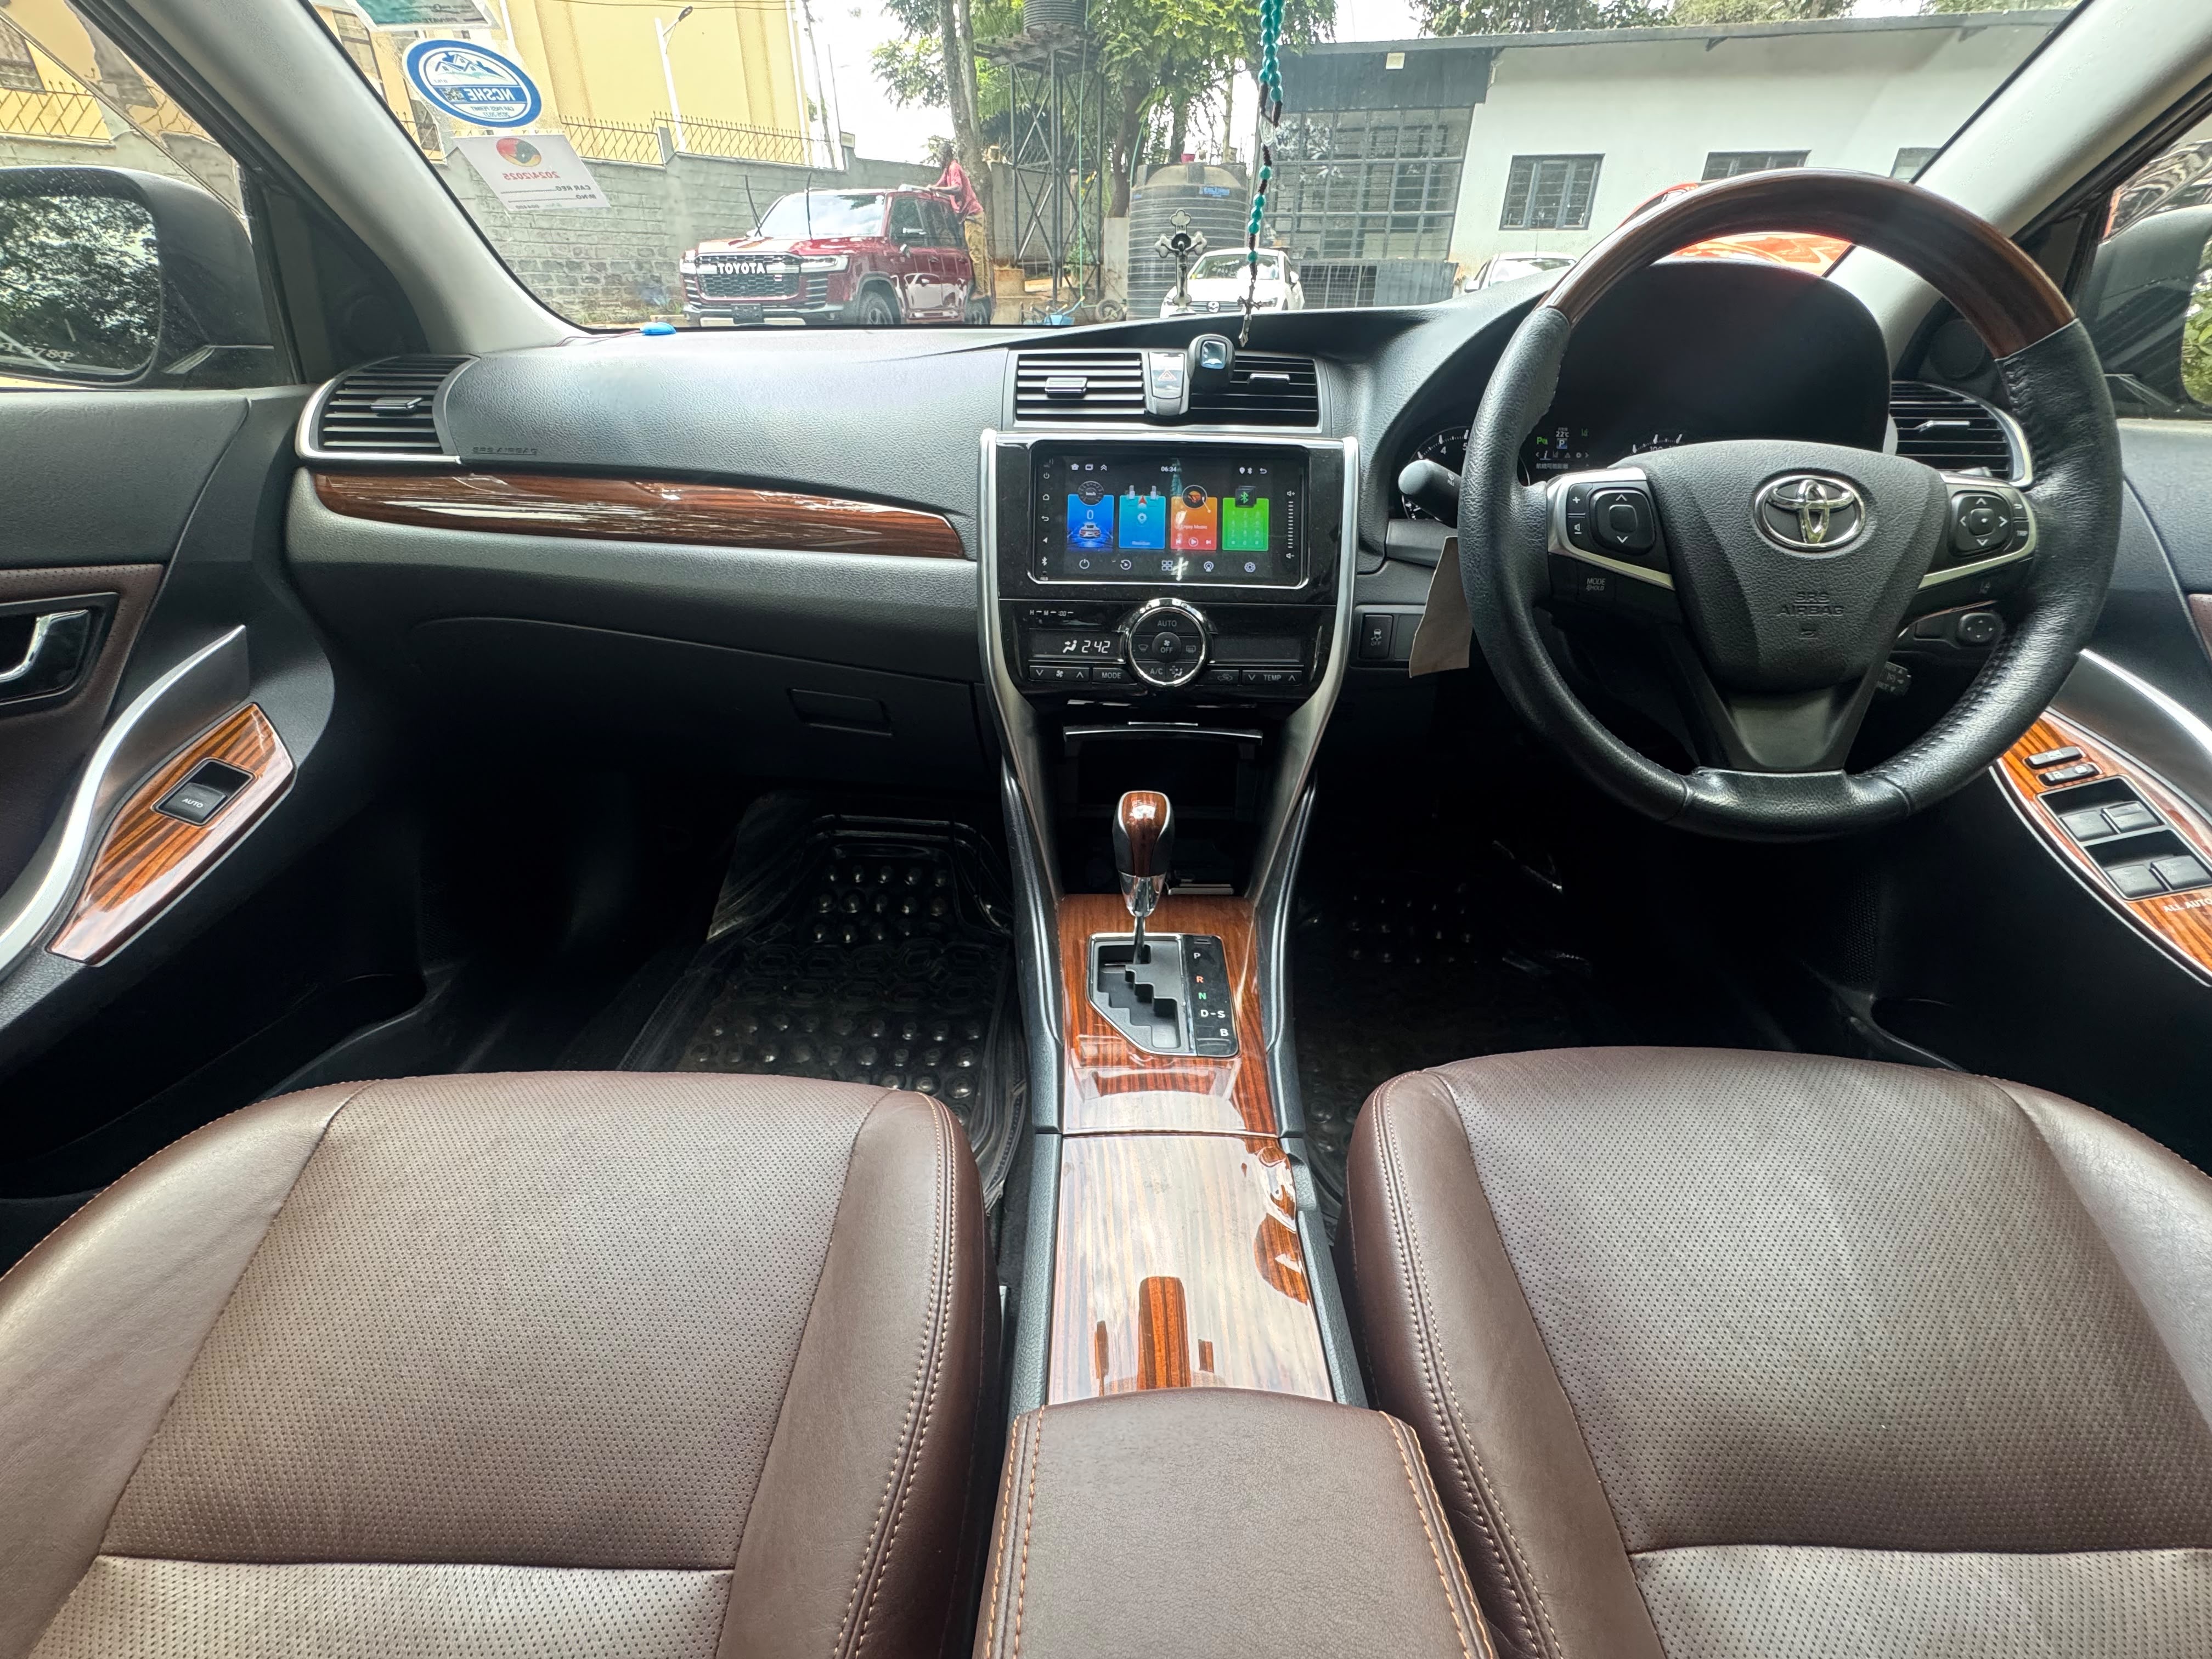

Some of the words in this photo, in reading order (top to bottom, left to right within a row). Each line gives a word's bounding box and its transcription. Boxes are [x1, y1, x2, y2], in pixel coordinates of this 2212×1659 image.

[717, 262, 766, 274] TOYOTA
[1440, 446, 1447, 455] 4
[1086, 509, 1094, 520] 0
[1794, 592, 1830, 603] SRS
[1776, 605, 1844, 617] AIRBAG
[182, 798, 204, 808] AUTO
[2163, 904, 2186, 912] ALL
[1220, 1028, 1229, 1036] B
